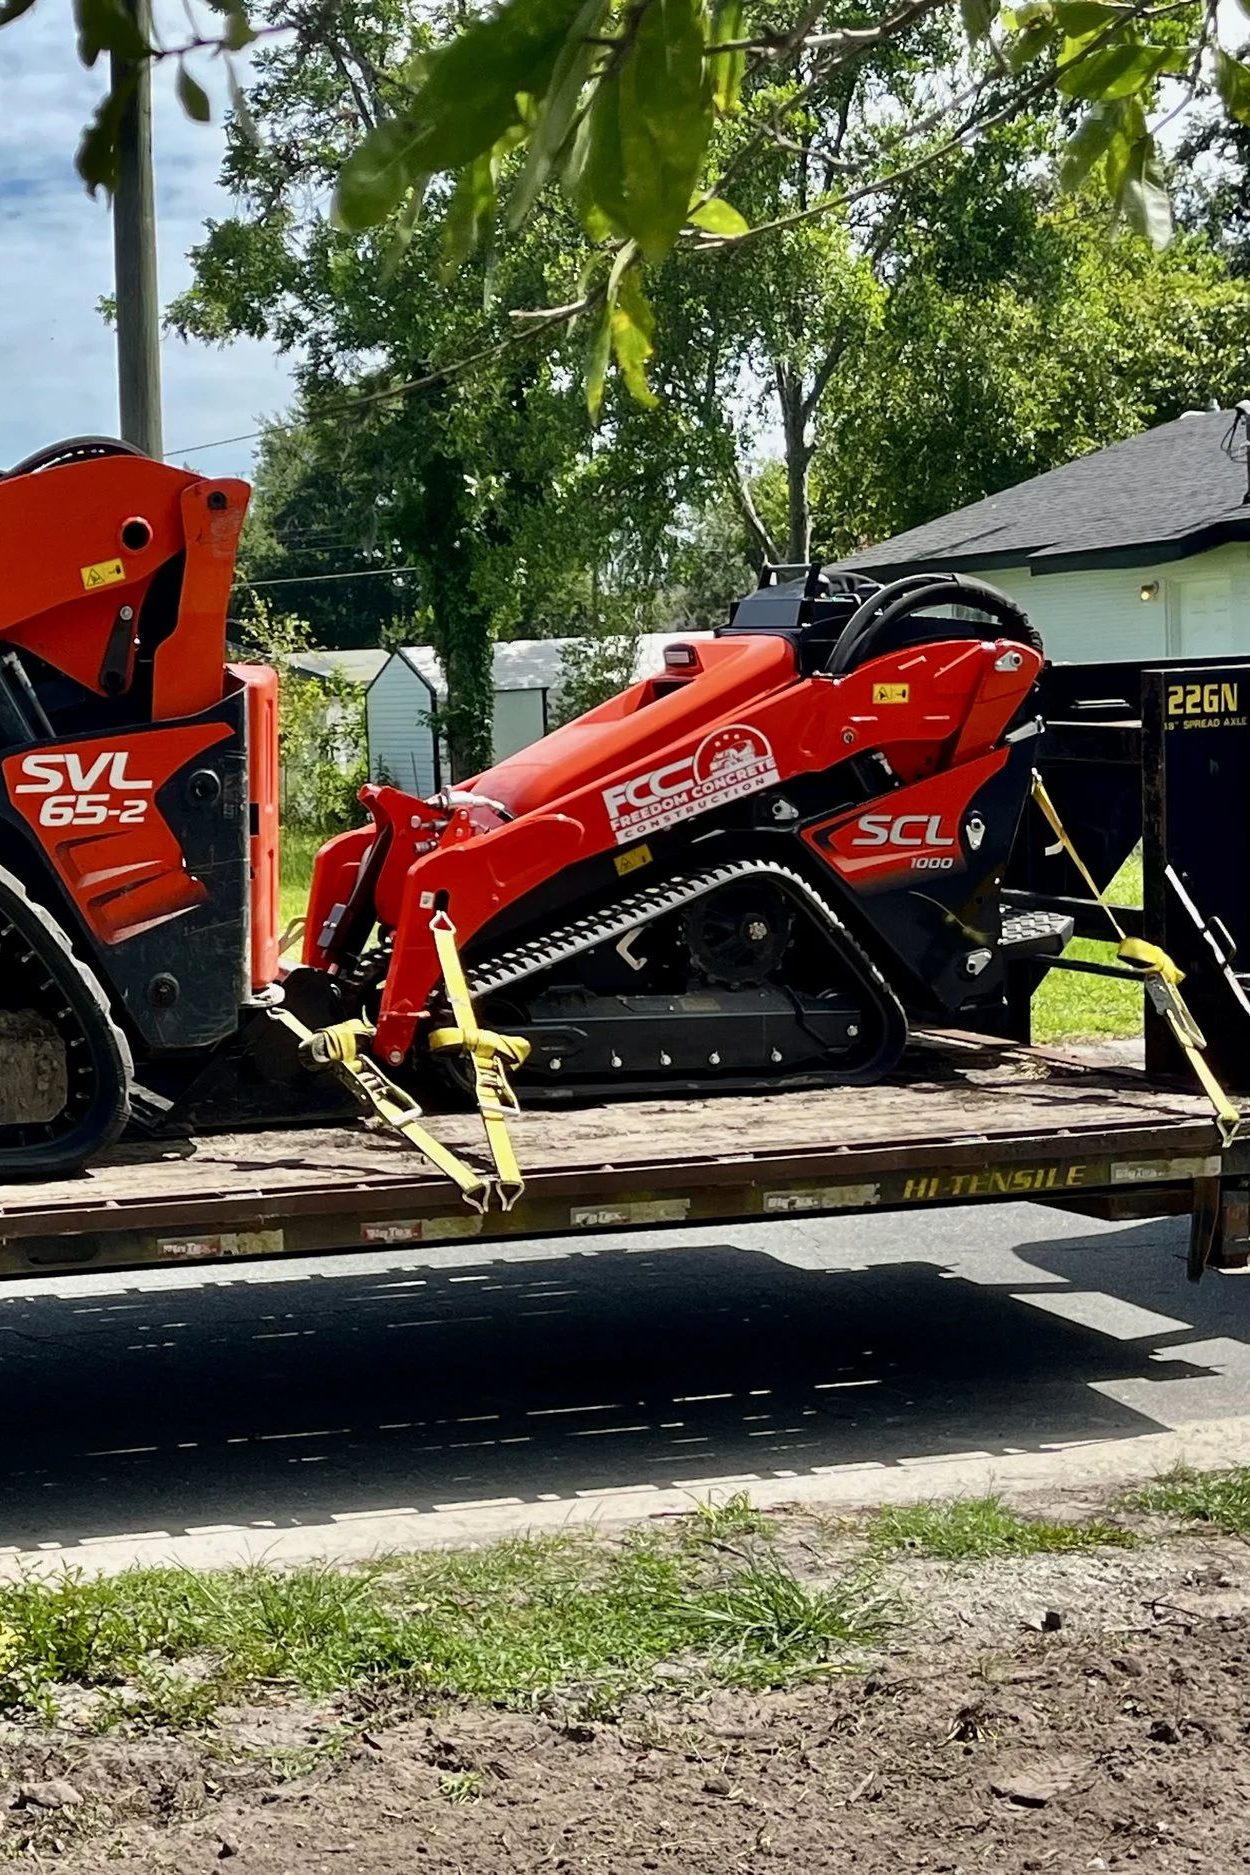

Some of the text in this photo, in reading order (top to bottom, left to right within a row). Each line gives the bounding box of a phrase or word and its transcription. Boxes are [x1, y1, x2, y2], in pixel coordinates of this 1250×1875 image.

[1168, 683, 1238, 715] 22GN
[1183, 718, 1221, 730] SPREAD
[1223, 716, 1248, 727] AXLE
[15, 752, 153, 794] SVL
[601, 756, 695, 819] FCC
[39, 793, 148, 827] 65-2
[610, 758, 778, 832] FREEDOM CONCRETE
[624, 777, 766, 838] CONSTRUCTION
[852, 815, 954, 846] SCL
[910, 857, 954, 869] 1000
